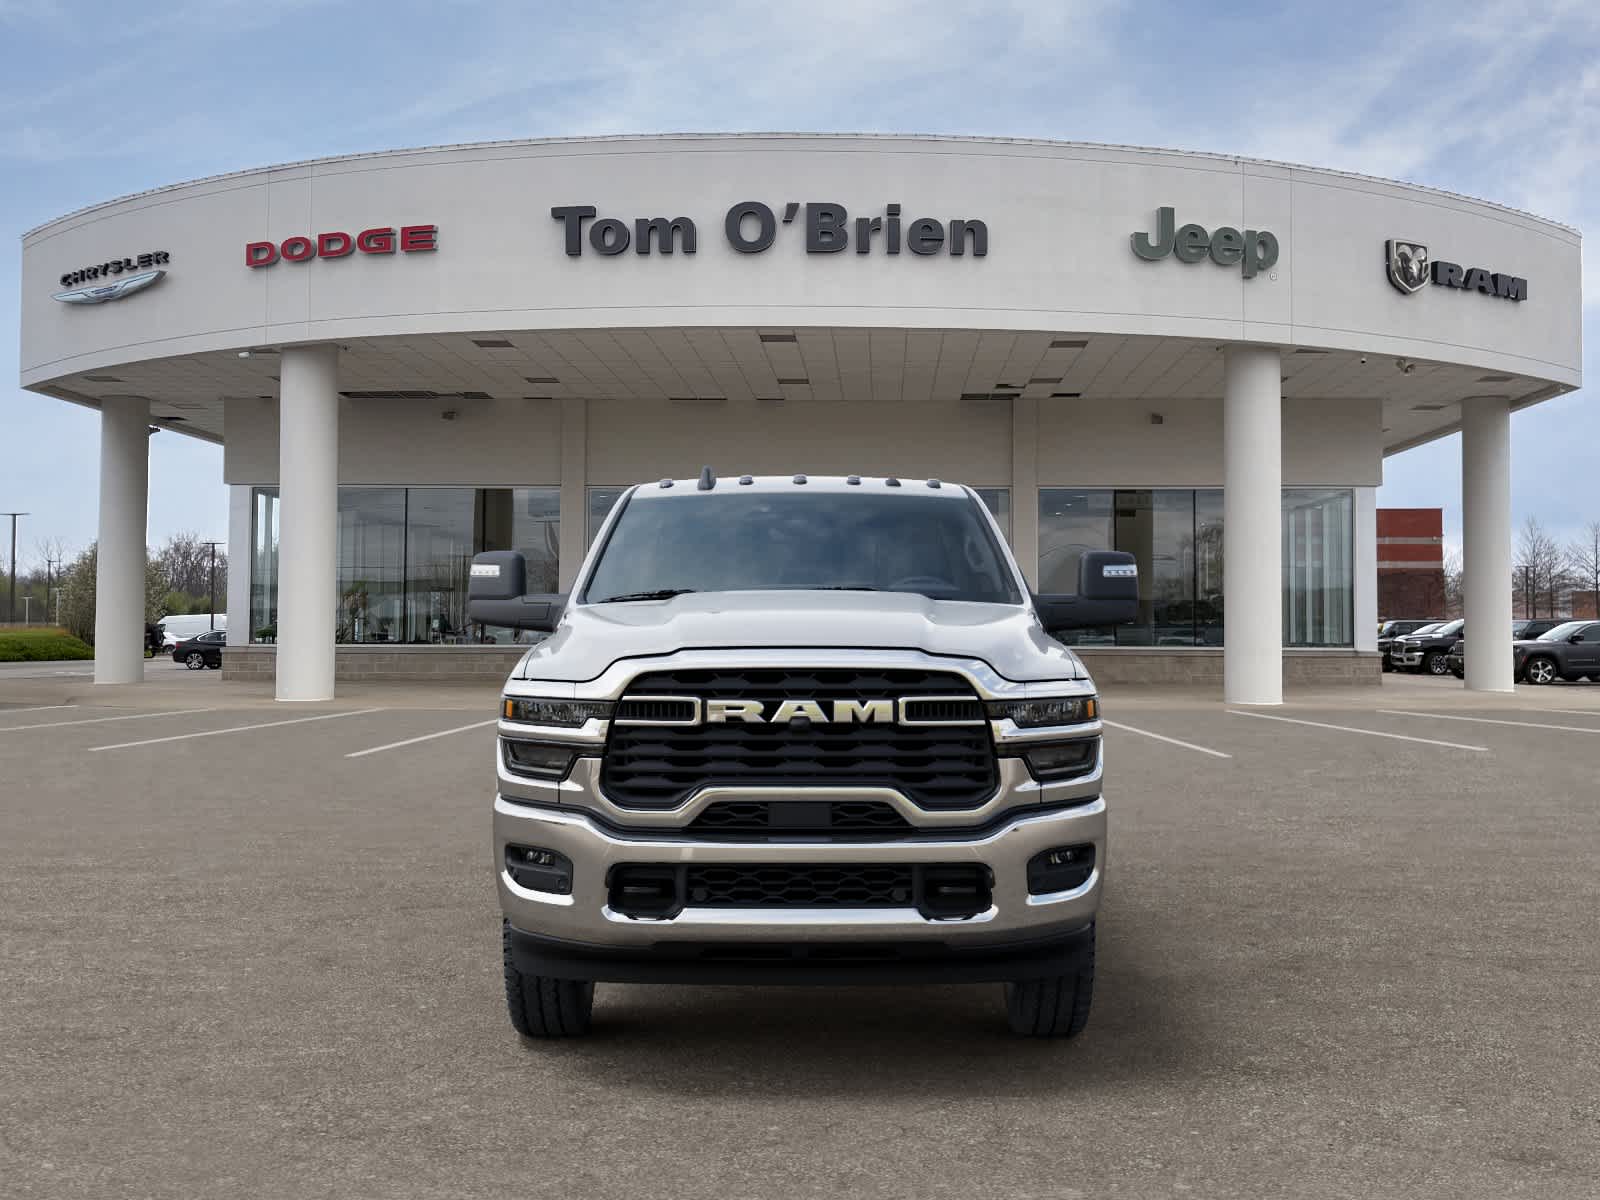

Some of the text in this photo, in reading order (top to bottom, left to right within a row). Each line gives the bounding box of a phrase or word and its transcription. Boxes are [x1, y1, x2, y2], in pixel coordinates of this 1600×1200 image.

[246, 225, 438, 269] DODGE
[551, 201, 988, 256] Tom O'Brien
[1130, 206, 1279, 279] Jeep
[60, 250, 170, 287] CHRYSLER
[1431, 261, 1528, 301] RAM
[706, 700, 894, 723] RAM
